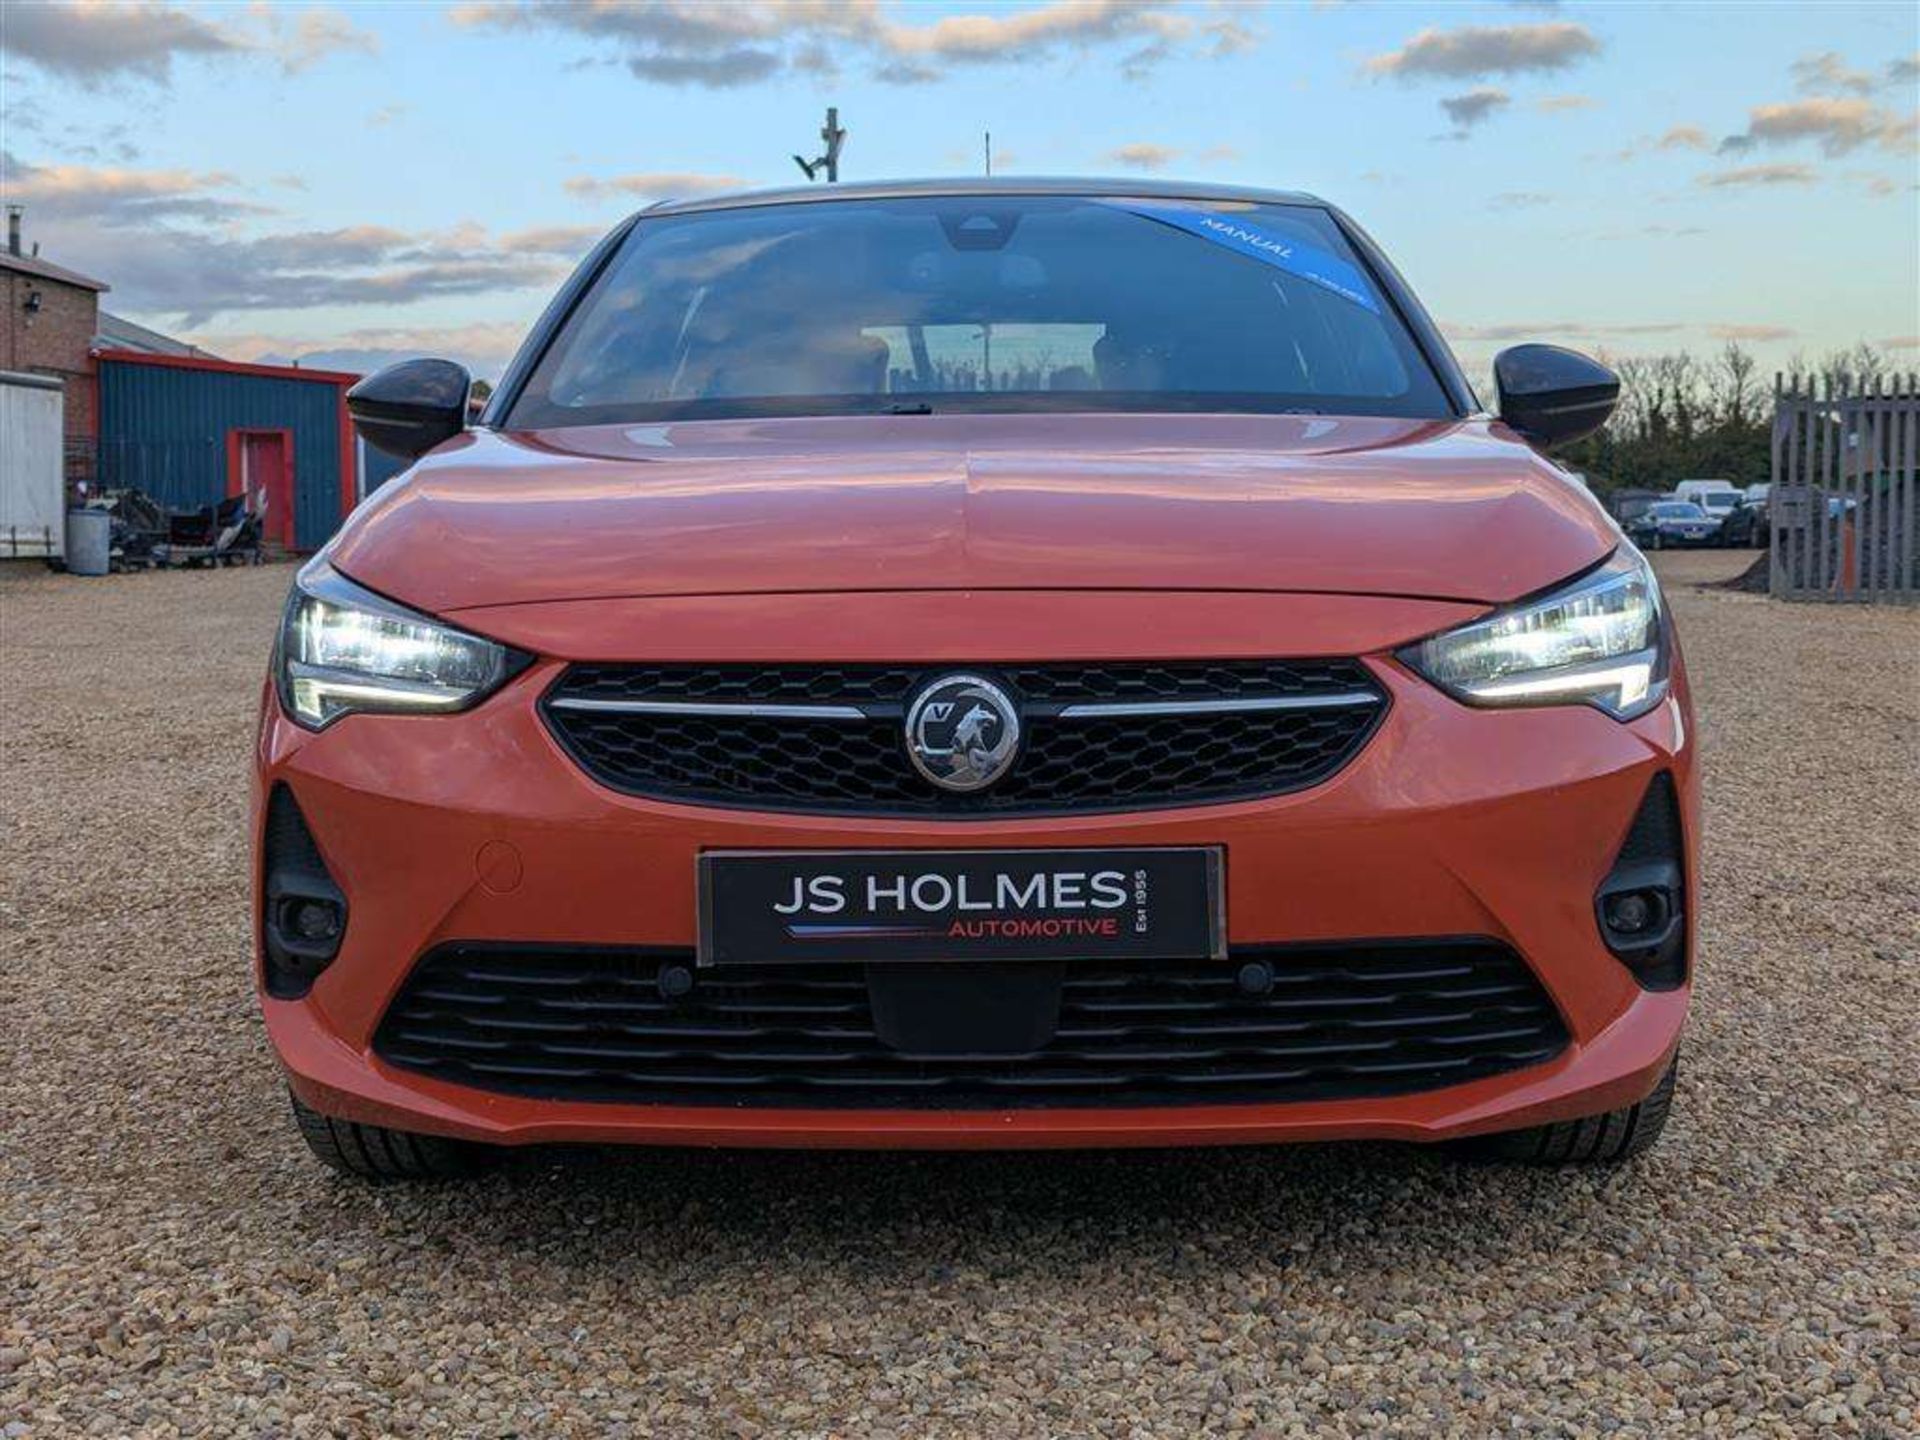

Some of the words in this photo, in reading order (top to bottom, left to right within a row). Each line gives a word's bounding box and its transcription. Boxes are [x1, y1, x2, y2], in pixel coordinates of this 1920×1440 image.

[1200, 216, 1292, 259] MANUAL
[773, 875, 846, 913] JS
[867, 871, 1128, 912] HOLMES
[1134, 869, 1147, 905] 1955
[949, 918, 1118, 938] AUTOMOTIVE
[1135, 909, 1147, 932] Est
